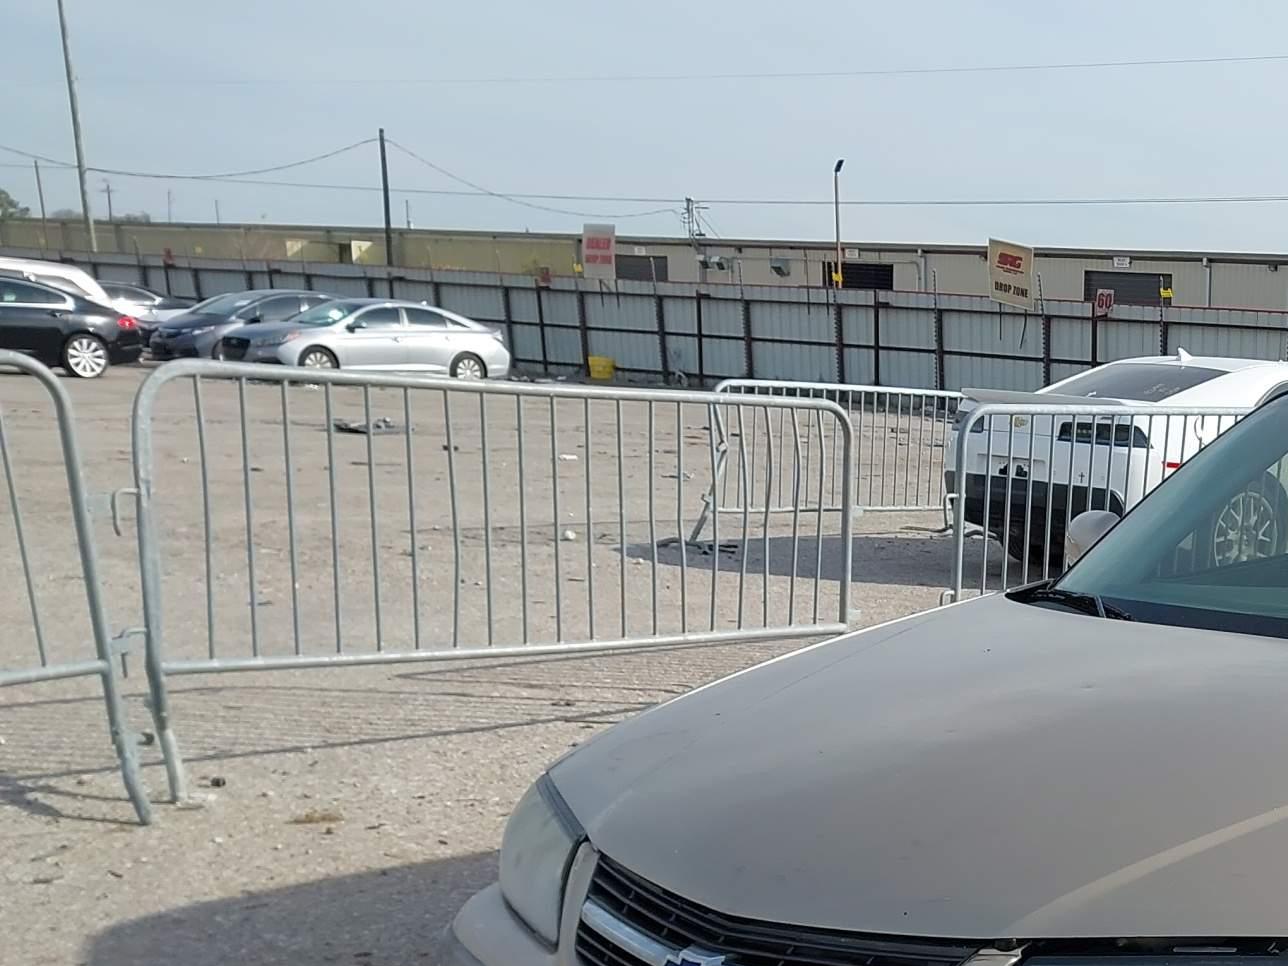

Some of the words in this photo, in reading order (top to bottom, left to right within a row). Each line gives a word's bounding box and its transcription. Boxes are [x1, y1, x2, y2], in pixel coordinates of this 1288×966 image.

[995, 281, 1012, 294] DROP
[1013, 286, 1028, 298] ZONE
[1097, 293, 1112, 309] 60
